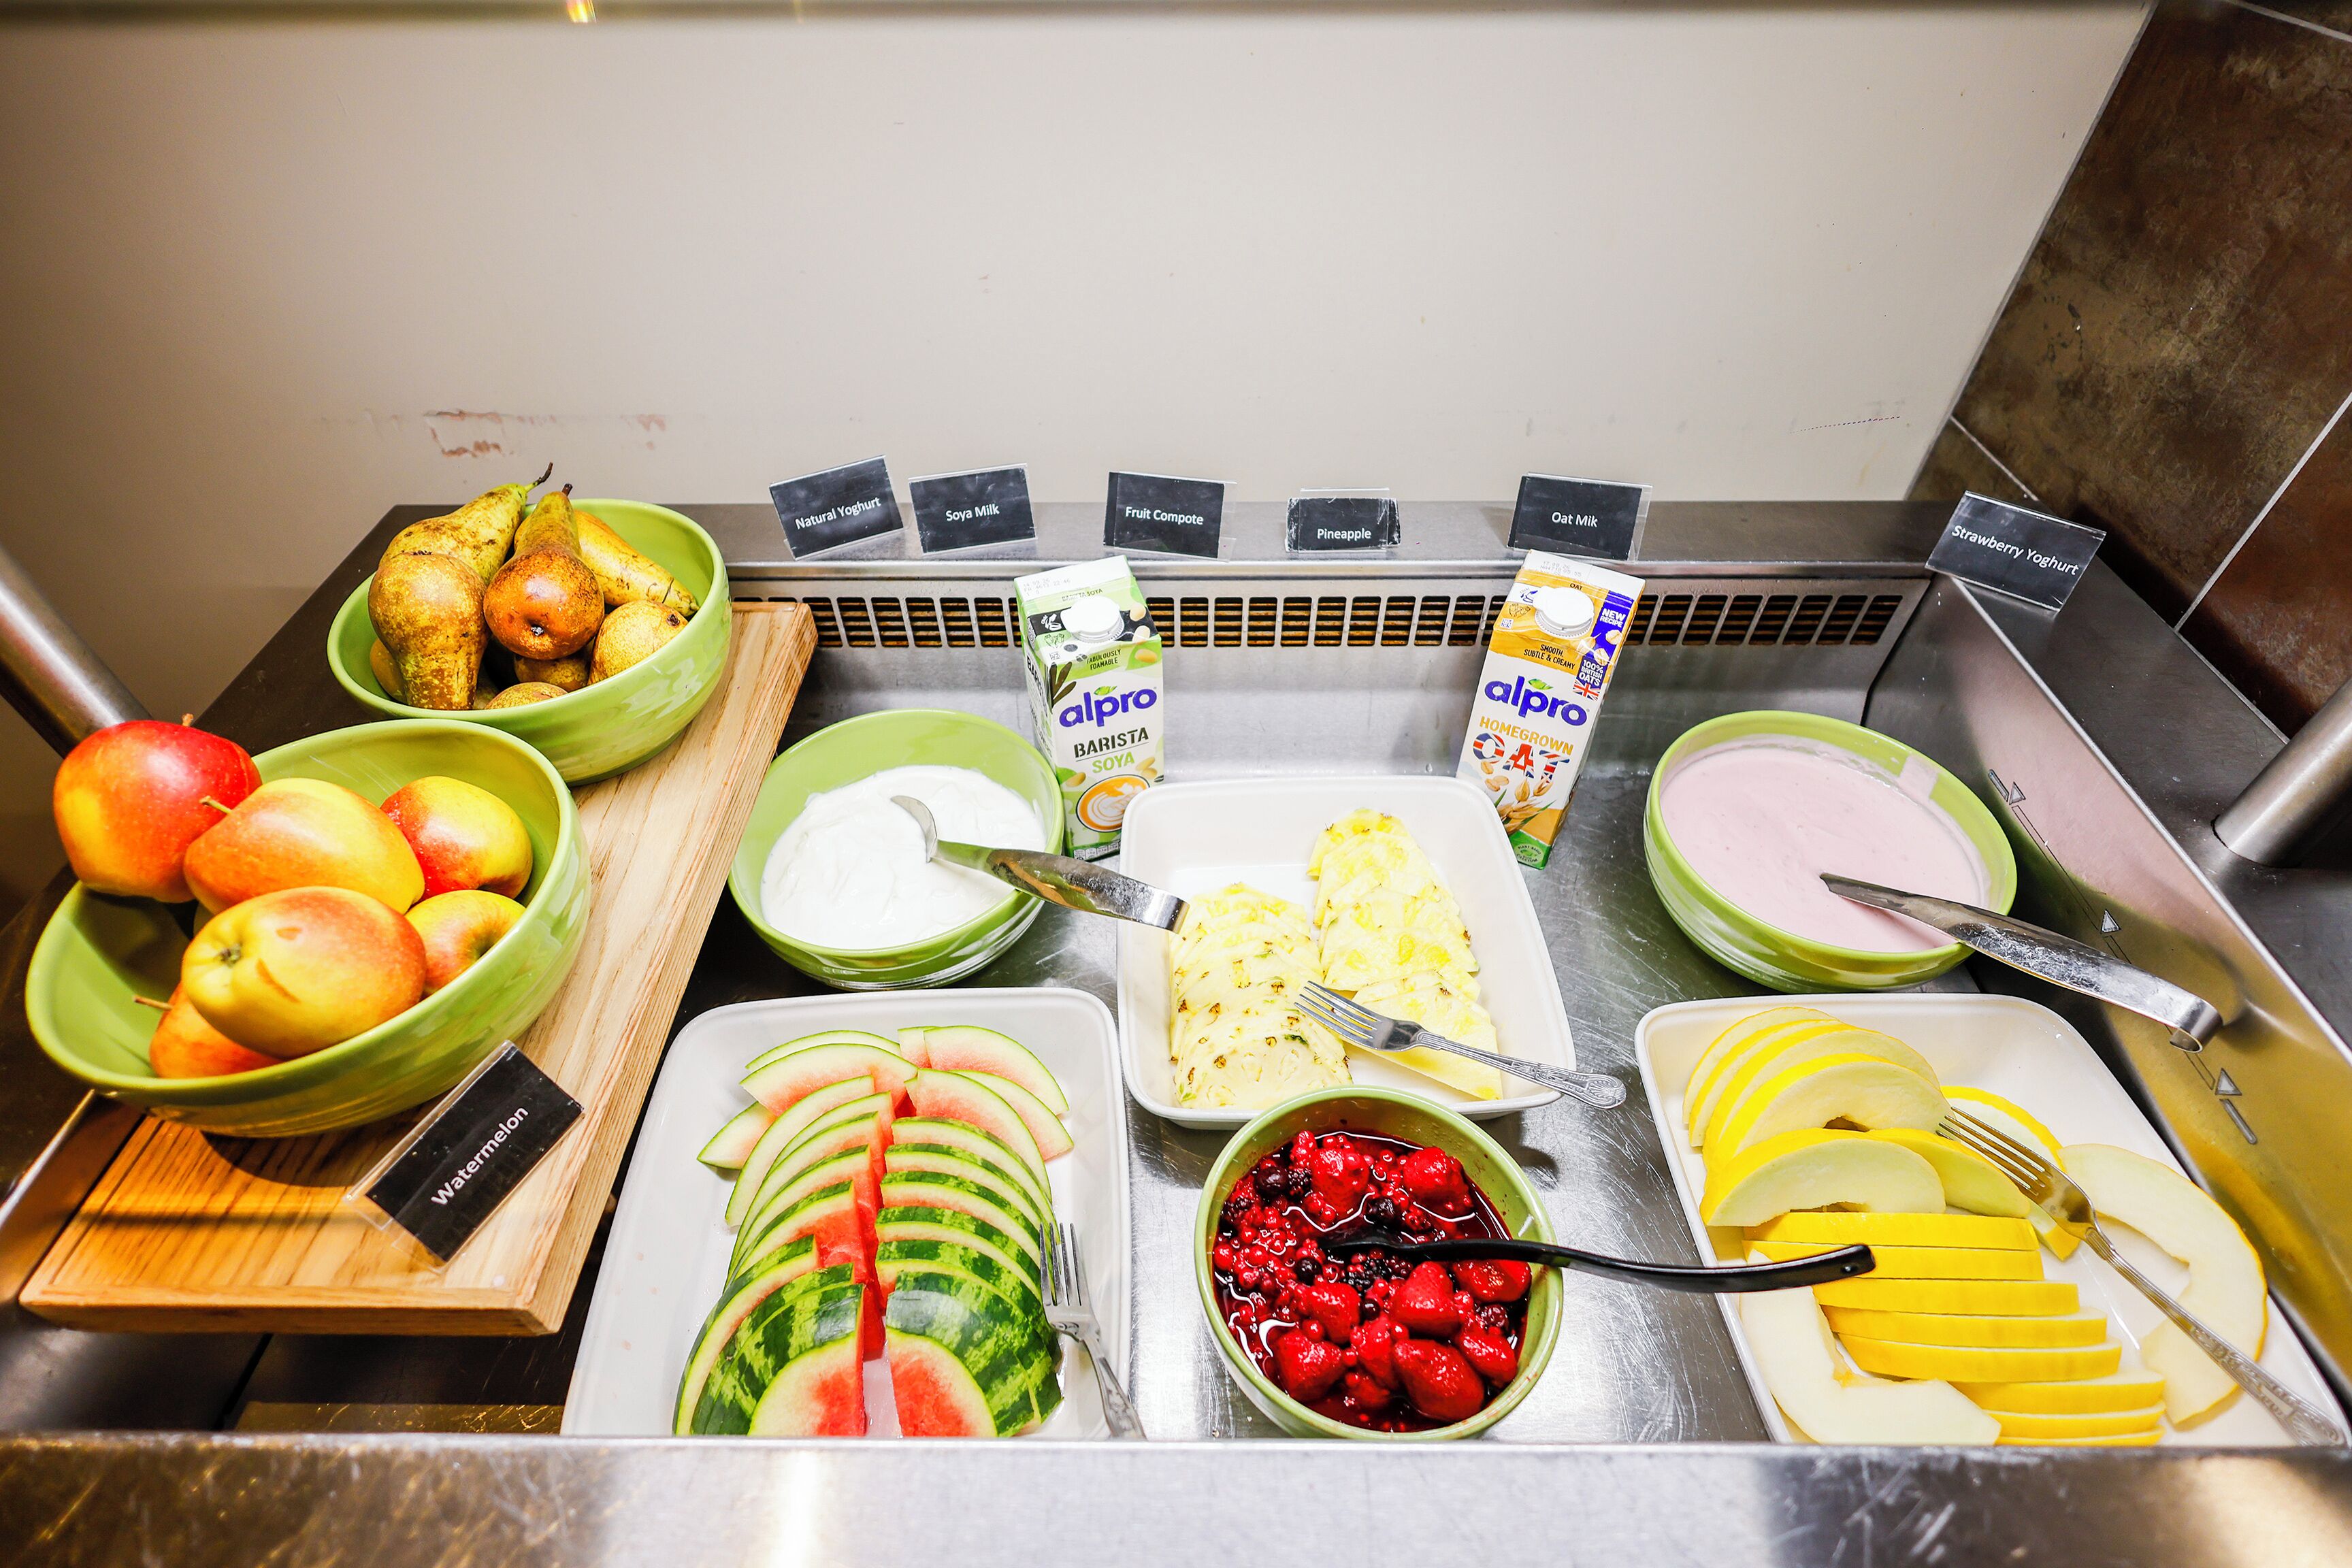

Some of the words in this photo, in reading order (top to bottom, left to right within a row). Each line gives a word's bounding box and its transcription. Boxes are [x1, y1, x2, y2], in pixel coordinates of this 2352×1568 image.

[795, 508, 837, 529] Natural
[837, 497, 881, 517] Yoghurt
[945, 510, 973, 522] Soya
[975, 504, 1000, 517] Milk
[1126, 506, 1152, 519] Fruit
[1153, 509, 1204, 525] Compote
[1552, 512, 1573, 525] Oat
[1575, 514, 1598, 527] Mik
[1317, 527, 1371, 541] Pineapple
[1952, 525, 2024, 559] Strawberry
[2025, 549, 2079, 576] Yoghurt
[1087, 588, 1103, 596] SOYA
[1569, 583, 1583, 591] OAT
[1599, 615, 1623, 628] RECIPE
[1601, 608, 1626, 621] NEW
[1086, 649, 1122, 664] FABULOUSLY
[1090, 657, 1118, 670] FOAMABLE
[1524, 649, 1544, 660] SUBTLE
[1553, 656, 1575, 670] CREAMY
[1581, 666, 1603, 679] BRITISH
[1583, 659, 1604, 674] 100%
[1579, 672, 1601, 687] OATS
[1059, 689, 1157, 728] alpro
[1484, 676, 1587, 726] alpro
[1074, 727, 1149, 758] BARISTA
[1479, 716, 1573, 755] HOMEGROWN
[1092, 751, 1134, 773] SOYA
[1473, 732, 1570, 783] OAT
[431, 1107, 529, 1205] Watermelon
